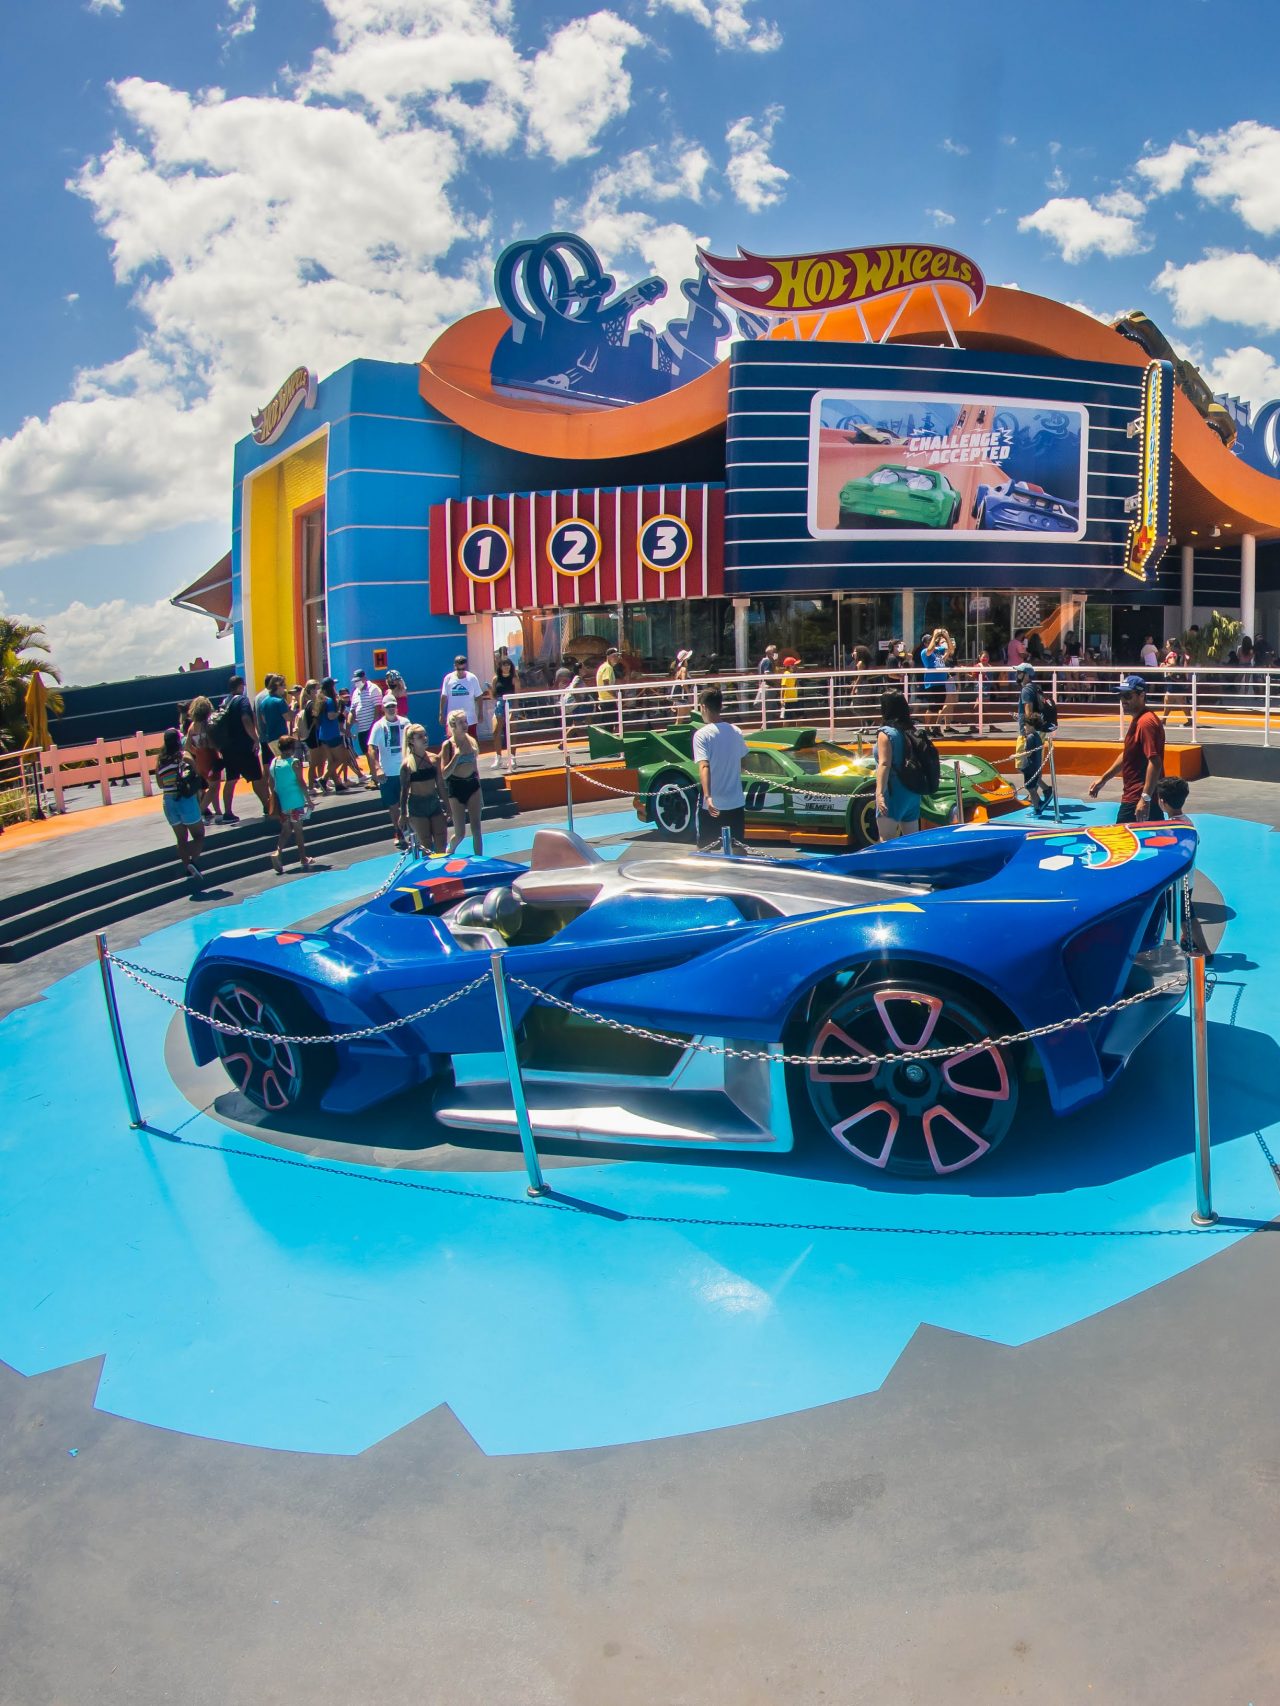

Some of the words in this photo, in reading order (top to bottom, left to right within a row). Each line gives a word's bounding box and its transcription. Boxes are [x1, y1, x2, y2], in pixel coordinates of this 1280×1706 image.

[909, 432, 1001, 452] CHALLENGE
[929, 446, 1011, 465] ACCEPTED
[477, 536, 492, 571] 1
[561, 530, 588, 565] 2
[652, 526, 678, 560] 3
